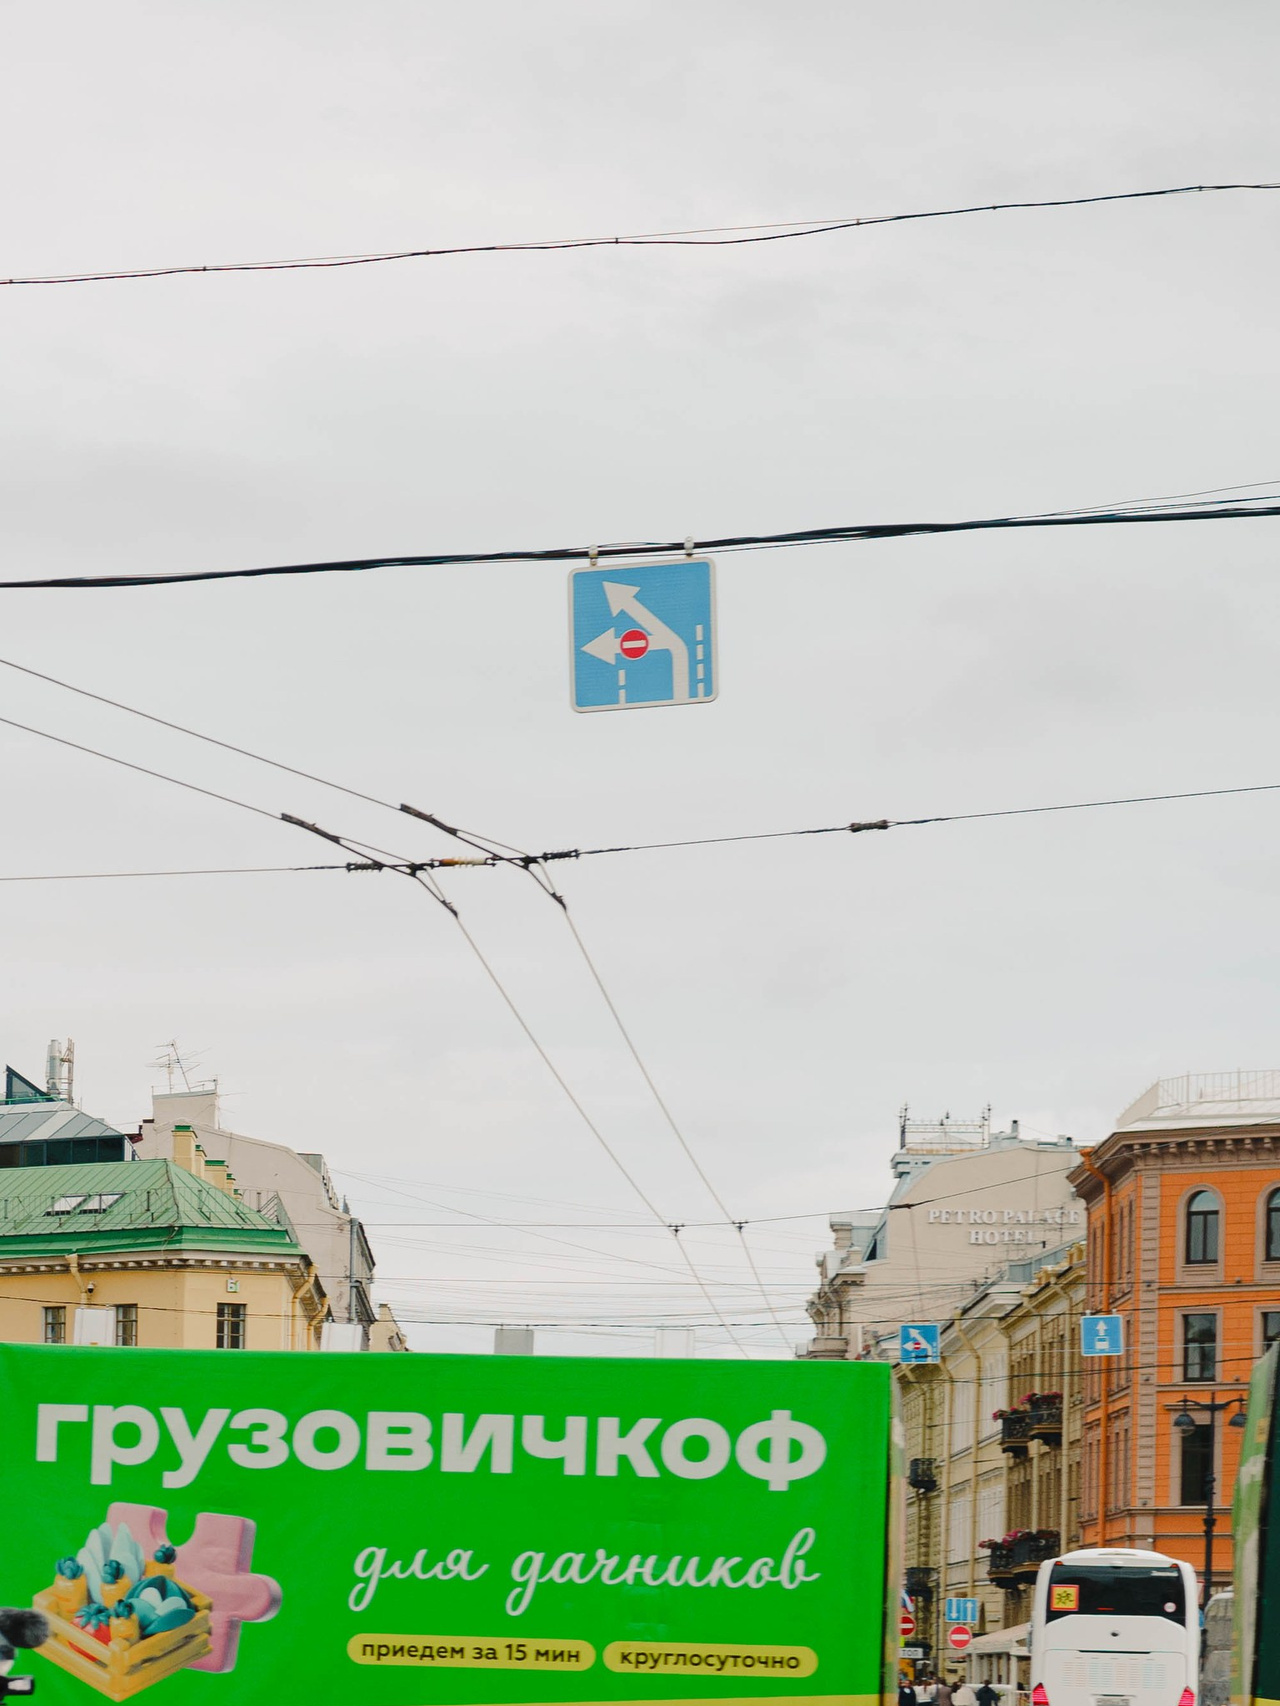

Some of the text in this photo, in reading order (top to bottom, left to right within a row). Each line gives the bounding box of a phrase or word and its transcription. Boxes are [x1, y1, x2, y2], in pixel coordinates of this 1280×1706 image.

[928, 1209, 1081, 1225] PETRO PALACE
[969, 1229, 1037, 1245] HOTEL
[37, 1404, 828, 1493] грузовичкоф
[349, 1528, 821, 1618] для дачников
[363, 1643, 581, 1664] приедем за 15 мин
[620, 1650, 801, 1670] круглосуточно
